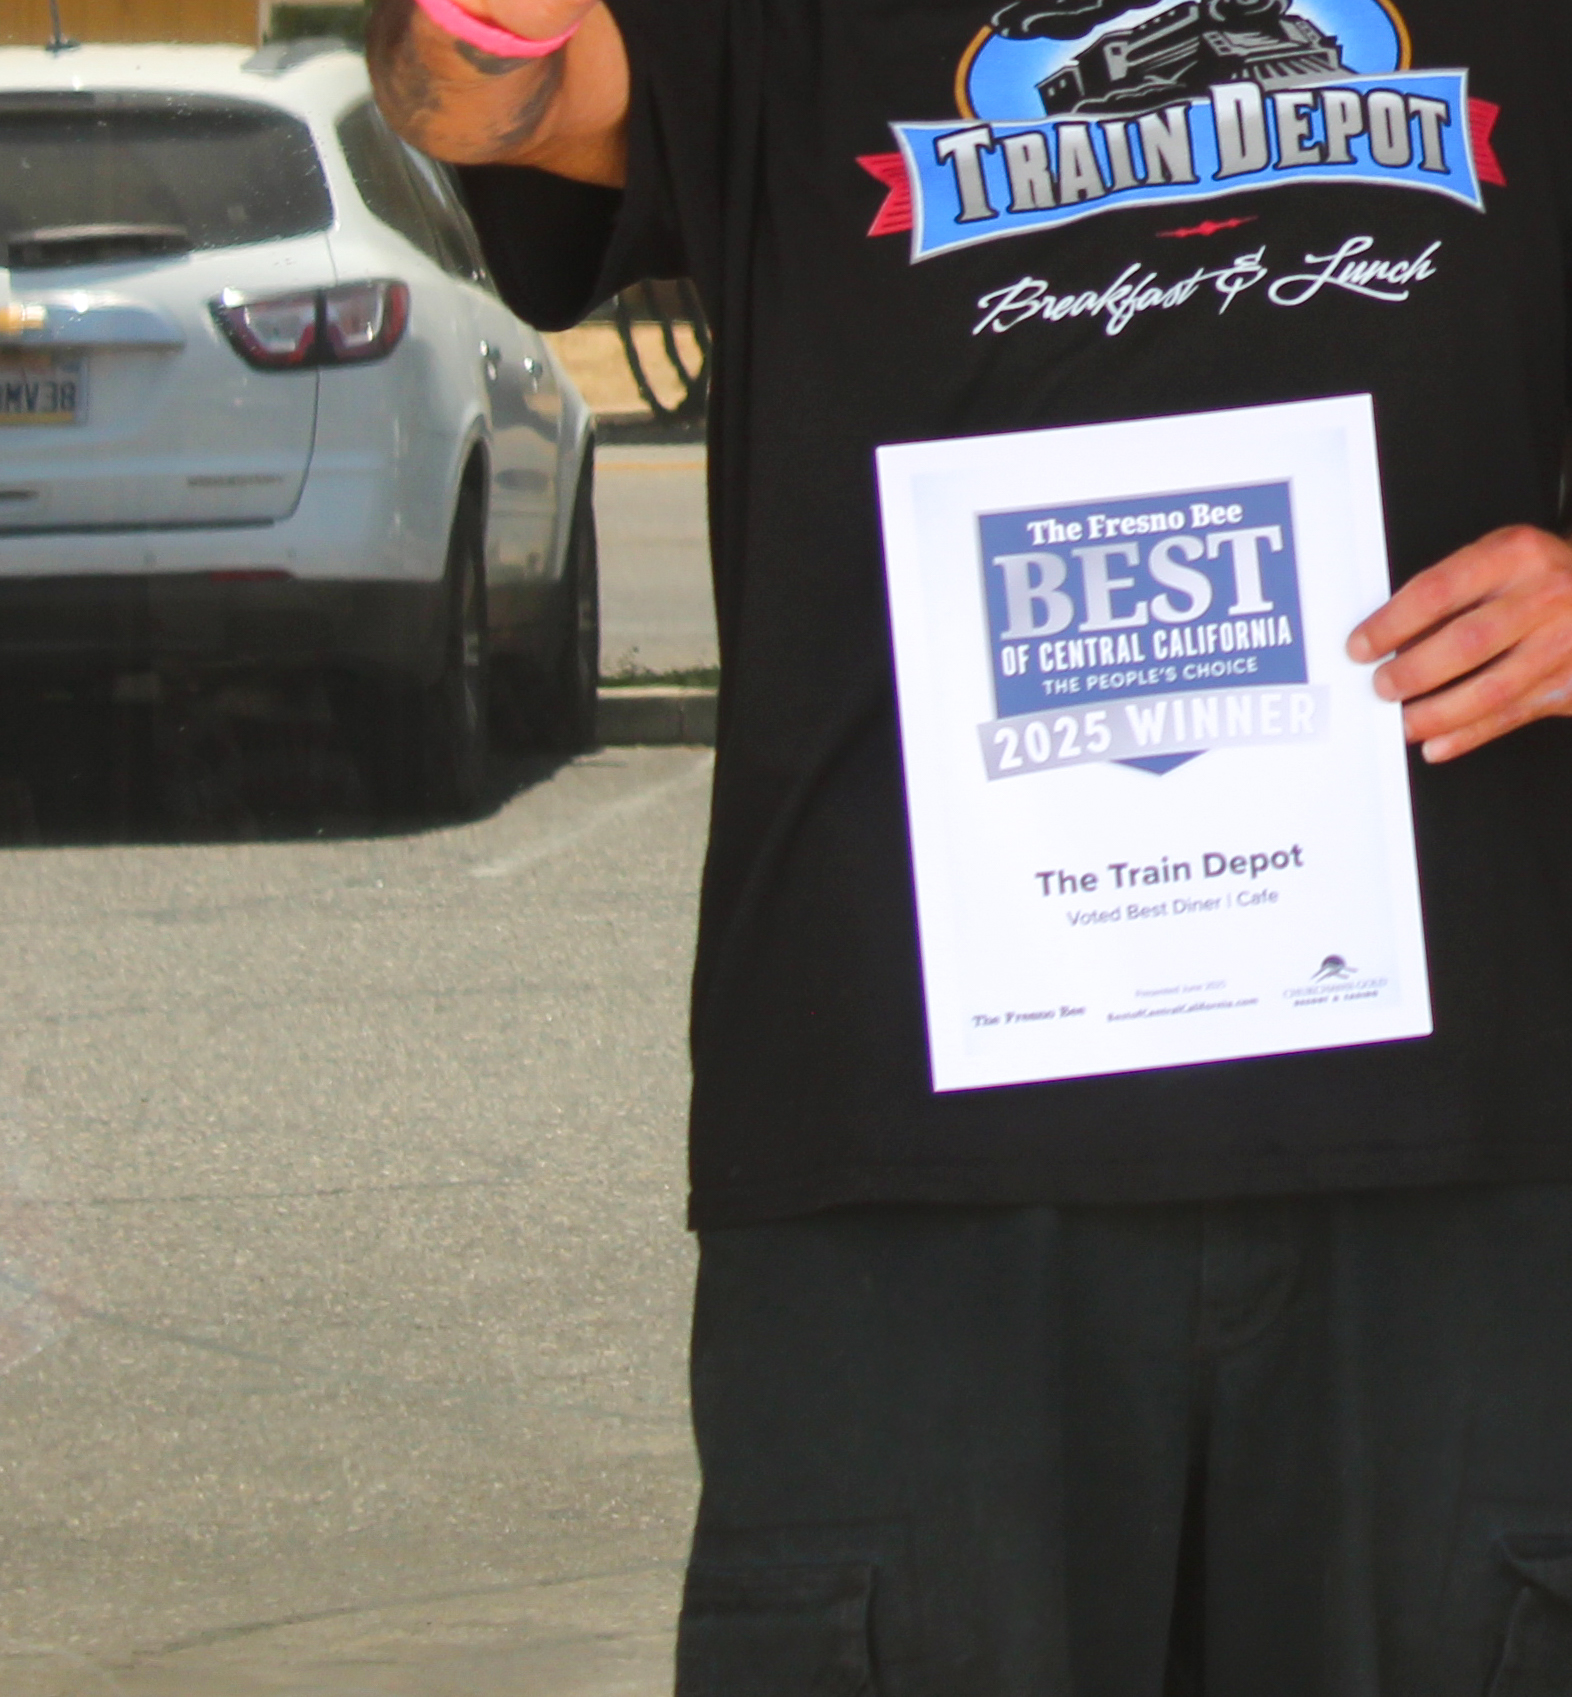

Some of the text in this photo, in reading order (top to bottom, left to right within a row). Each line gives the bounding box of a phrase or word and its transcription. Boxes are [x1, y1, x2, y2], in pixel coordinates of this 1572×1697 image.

[936, 79, 1452, 224] TRAIN DEPOT
[972, 263, 1205, 336] Breakfast
[1268, 235, 1442, 306] Lunch
[1027, 502, 1244, 546] The Fresno Bee
[991, 524, 1284, 641] BEST
[1001, 614, 1293, 678] OF CENTRAL CALIFORNIA
[1041, 655, 1259, 696] THE PEOPLE'S CHOICE
[993, 692, 1317, 771] 2025 WINNER
[1034, 843, 1305, 898] The Train Depot
[1066, 905, 1122, 928] Voted
[1126, 900, 1168, 921] Best
[1172, 893, 1223, 916] Diner
[1235, 888, 1281, 908] Cafe
